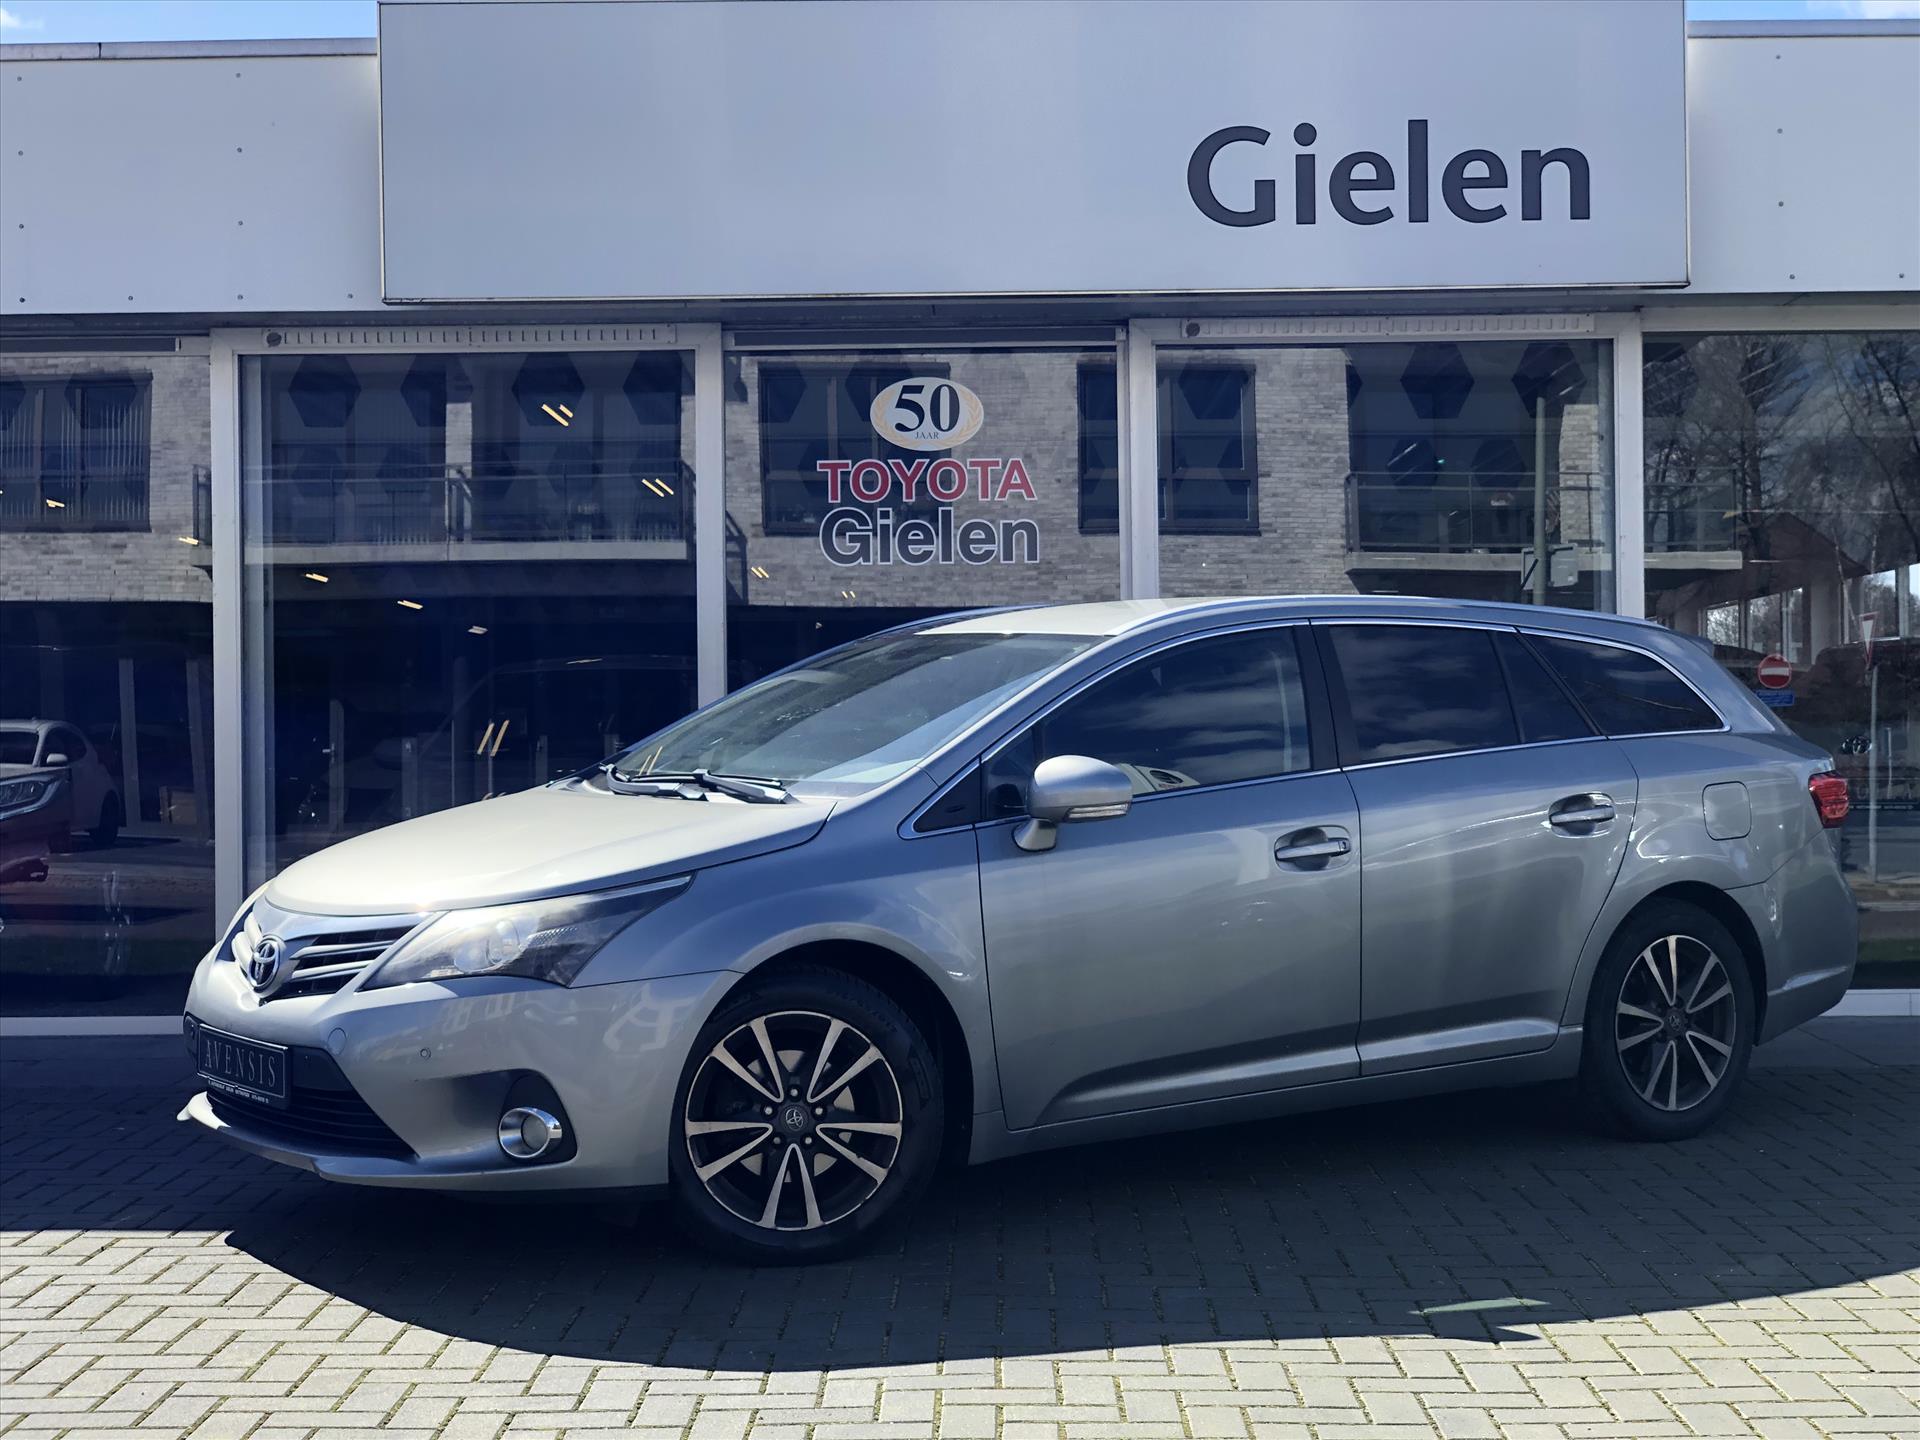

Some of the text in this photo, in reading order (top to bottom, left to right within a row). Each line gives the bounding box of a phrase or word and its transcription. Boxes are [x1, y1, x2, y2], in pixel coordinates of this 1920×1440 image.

[1187, 119, 1591, 228] Gielen
[895, 383, 960, 433] 50
[914, 430, 940, 440] JAAR
[816, 458, 1038, 503] TOYOTA
[819, 506, 1040, 567] Gielen
[204, 1039, 277, 1088] AVENSIS
